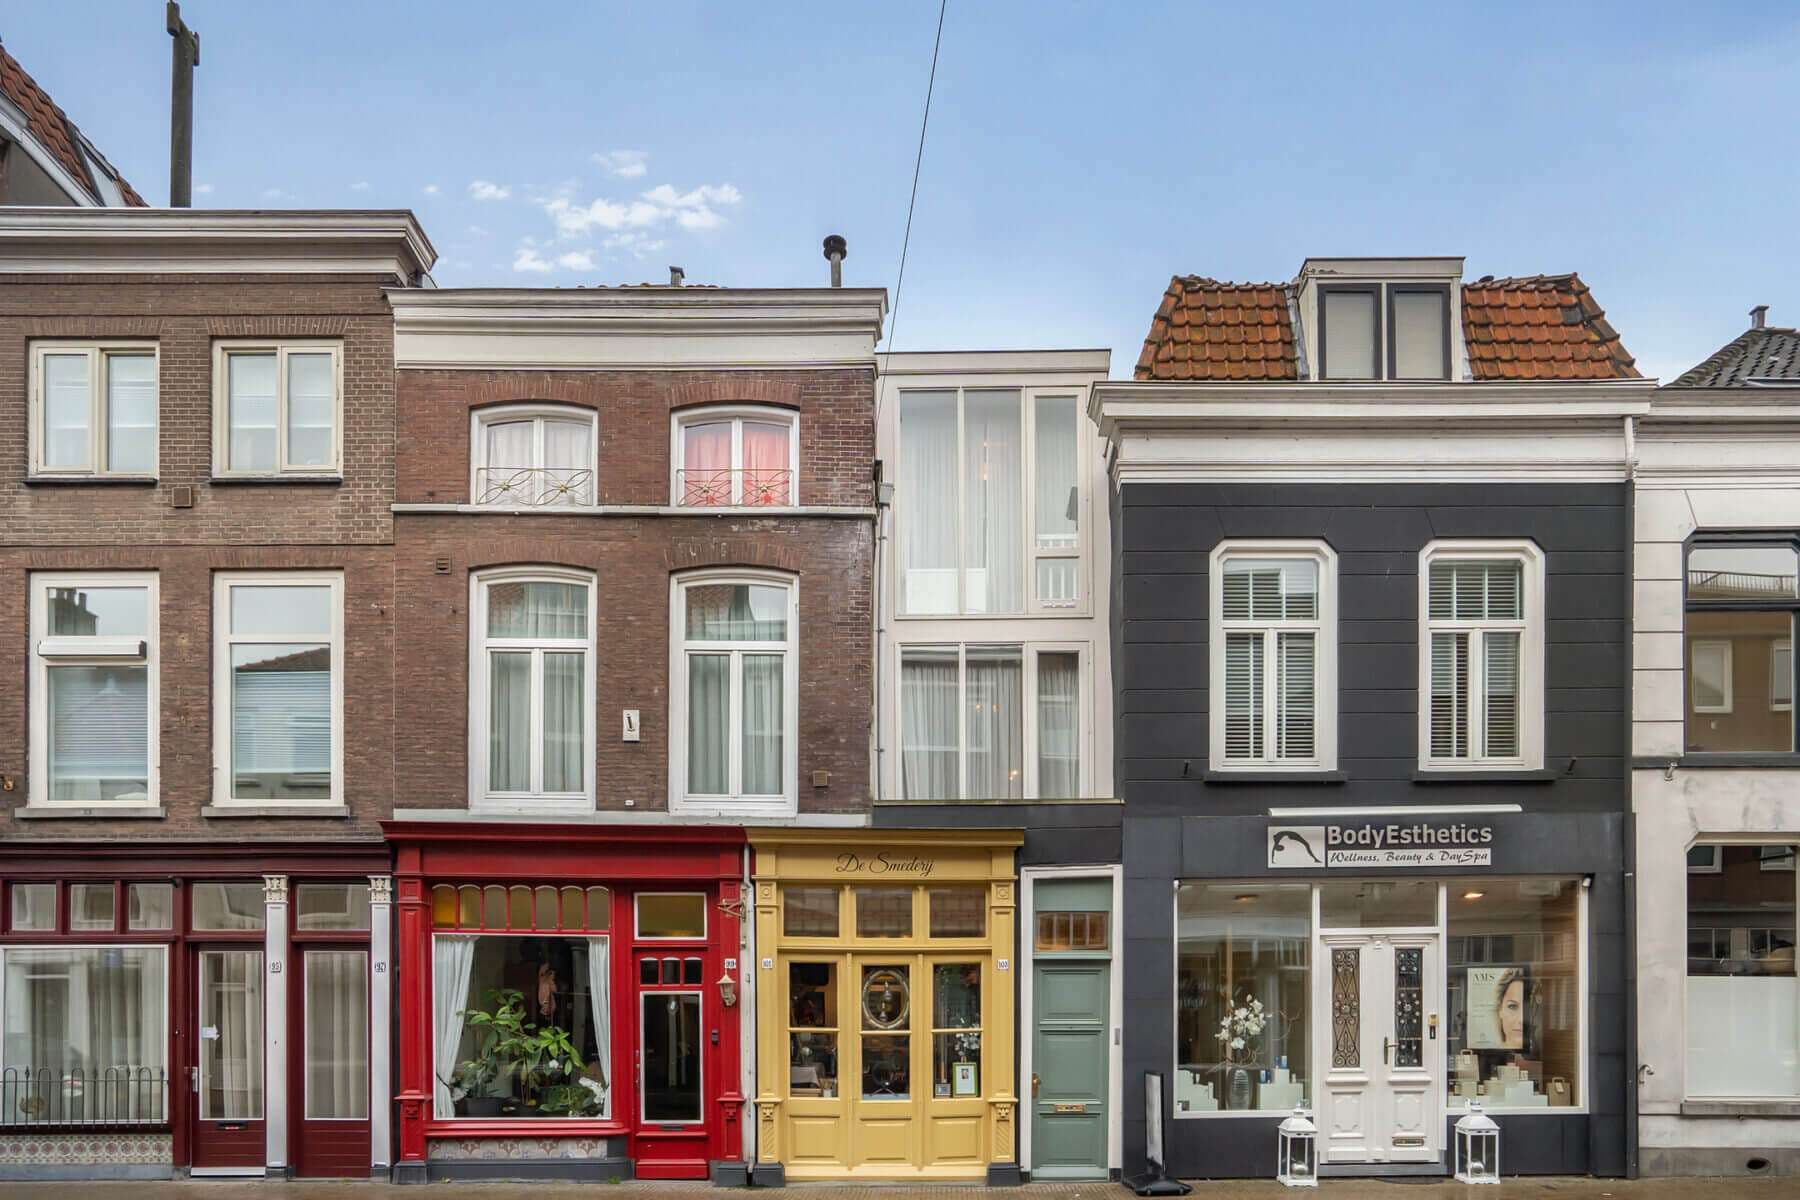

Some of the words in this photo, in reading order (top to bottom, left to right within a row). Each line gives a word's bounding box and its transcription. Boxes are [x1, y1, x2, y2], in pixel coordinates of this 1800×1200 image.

[1327, 823, 1493, 849] BodyEsthetics
[836, 852, 865, 872] De
[869, 852, 935, 877] Smederij
[1330, 851, 1380, 863] Wellness,
[1384, 851, 1422, 864] Beauty
[1425, 852, 1434, 861] &
[1440, 850, 1488, 864] DaySpa
